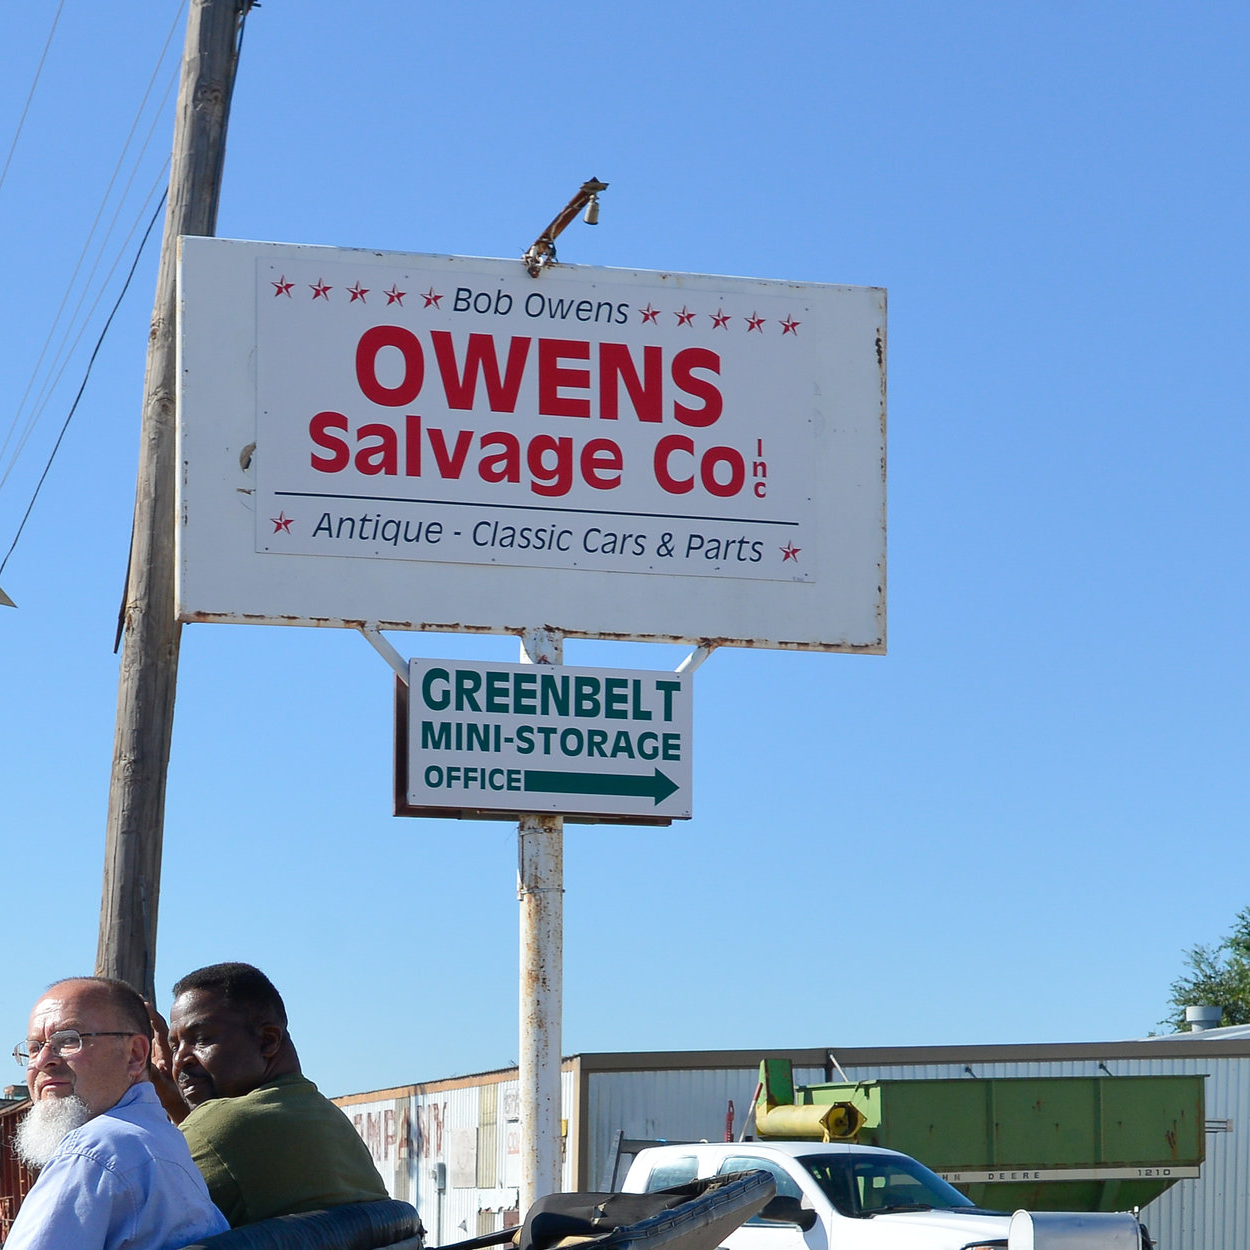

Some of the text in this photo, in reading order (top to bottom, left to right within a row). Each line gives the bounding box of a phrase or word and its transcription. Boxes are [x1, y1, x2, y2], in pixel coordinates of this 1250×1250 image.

[453, 287, 630, 325] Bob Owens
[355, 325, 724, 428] OWENS
[308, 411, 746, 498] Salvage Co
[752, 438, 768, 499] Inc
[311, 512, 443, 547] Antique
[472, 519, 574, 553] Classic
[582, 527, 647, 556] Cars
[656, 532, 675, 558] &
[685, 533, 764, 563] Parts
[421, 667, 681, 722] GREENBELT
[421, 720, 681, 762] MINI-STORAGE
[424, 765, 522, 792] OFFICE
[354, 1102, 448, 1161] MPANY
[988, 1171, 1040, 1181] DEERE
[1137, 1168, 1171, 1177] 1210
